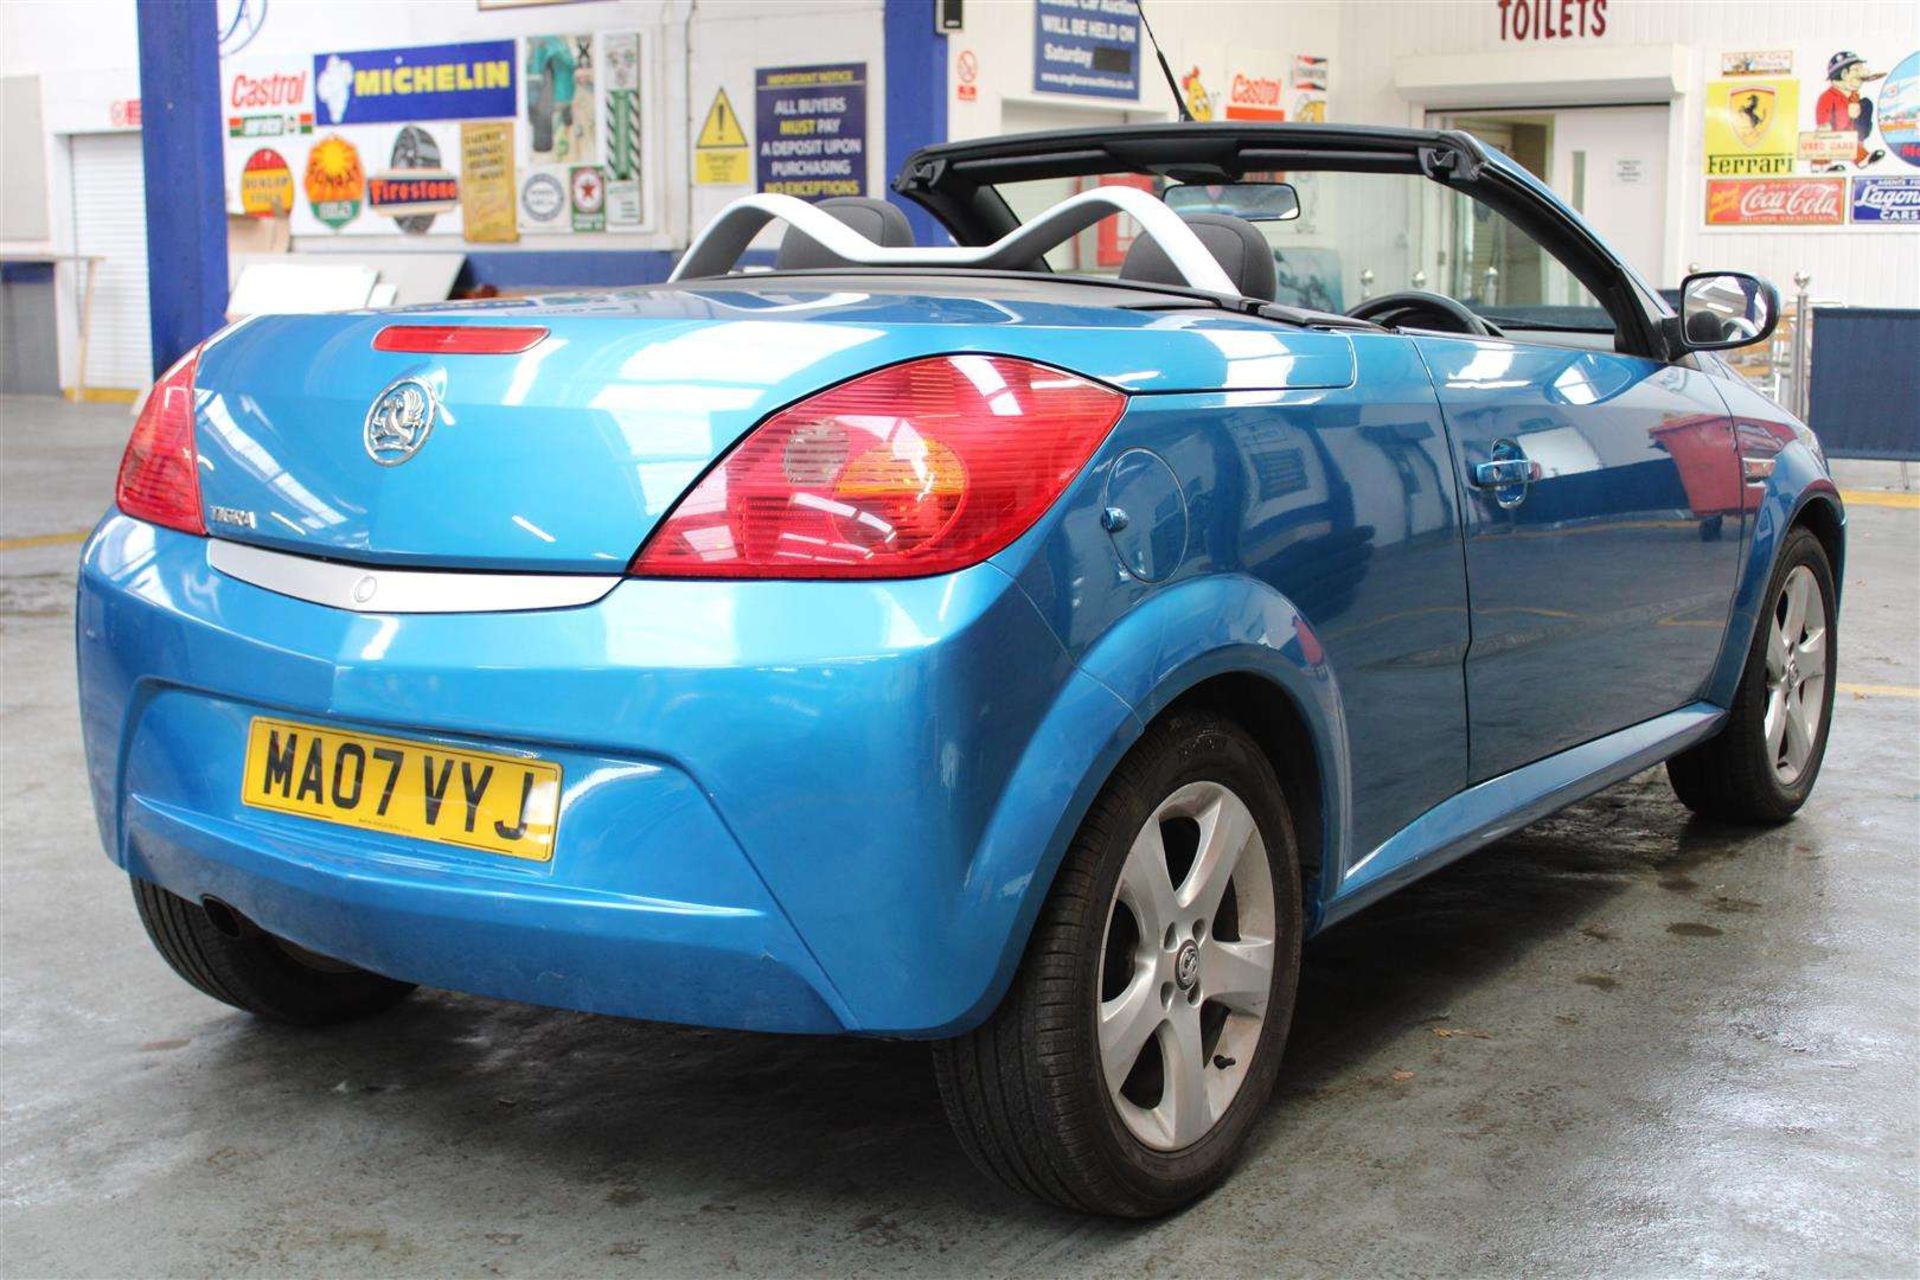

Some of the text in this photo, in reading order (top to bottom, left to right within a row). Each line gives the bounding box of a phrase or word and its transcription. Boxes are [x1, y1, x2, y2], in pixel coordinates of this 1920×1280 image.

[1041, 14, 1136, 43] WILL BE HELD ON
[1498, 0, 1607, 40] TOILETS
[1044, 43, 1094, 69] Saturday
[232, 71, 307, 108] Castrol
[354, 60, 511, 97] MICHELIN
[766, 70, 854, 86] IMPORTANT NOTICE
[1232, 74, 1283, 105] Castrol
[774, 97, 846, 116] ALL BUYERS
[779, 118, 841, 135] MUST PAY
[761, 138, 862, 156] A DEPOSIT UPON
[771, 160, 852, 177] PURCHASING
[1707, 154, 1794, 174] Ferrari
[370, 179, 457, 208] Firestone
[764, 180, 860, 195] NO EXCEPTIONS
[1740, 183, 1840, 217] Coca-Cola
[1879, 210, 1919, 221] CARS
[263, 730, 536, 842] MA07 VYJ
